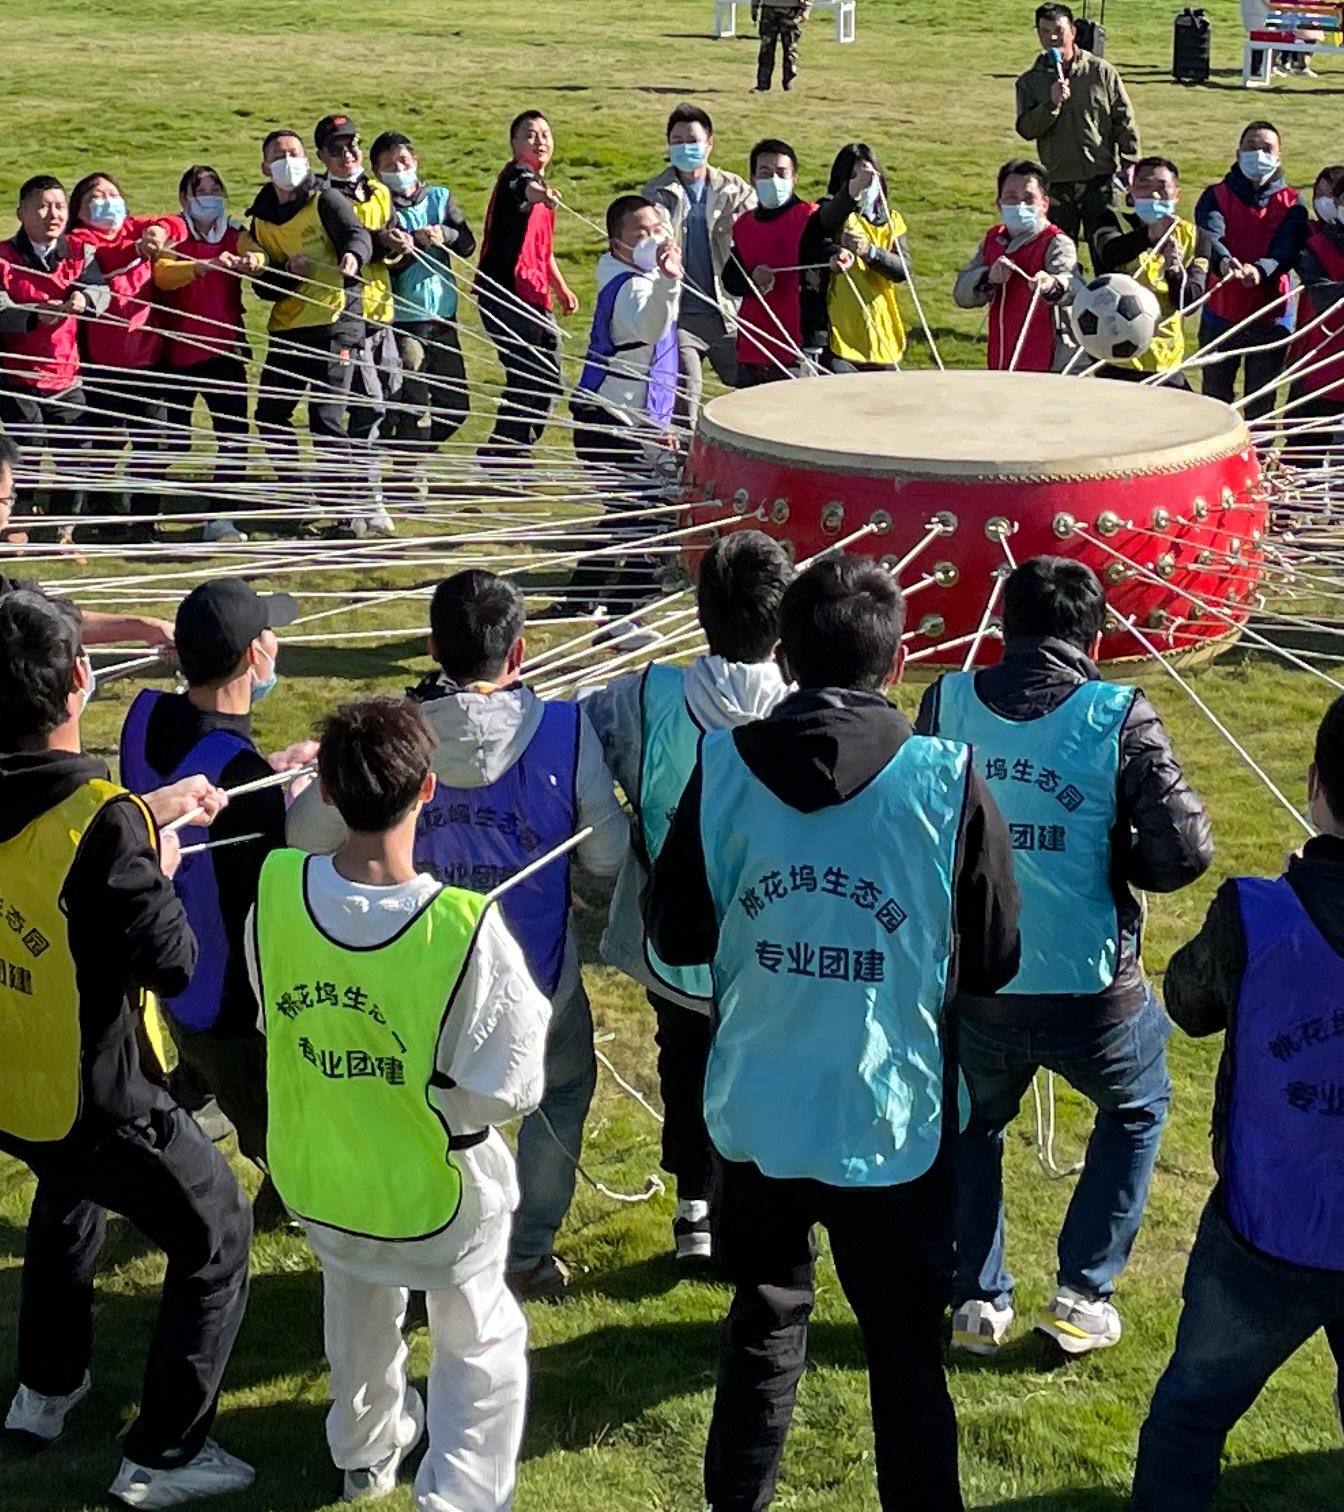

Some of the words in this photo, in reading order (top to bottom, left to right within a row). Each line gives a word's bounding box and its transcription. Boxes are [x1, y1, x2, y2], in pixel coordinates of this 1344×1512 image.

[738, 864, 908, 934] 桃花坞生态园
[755, 939, 886, 983] 专业团建
